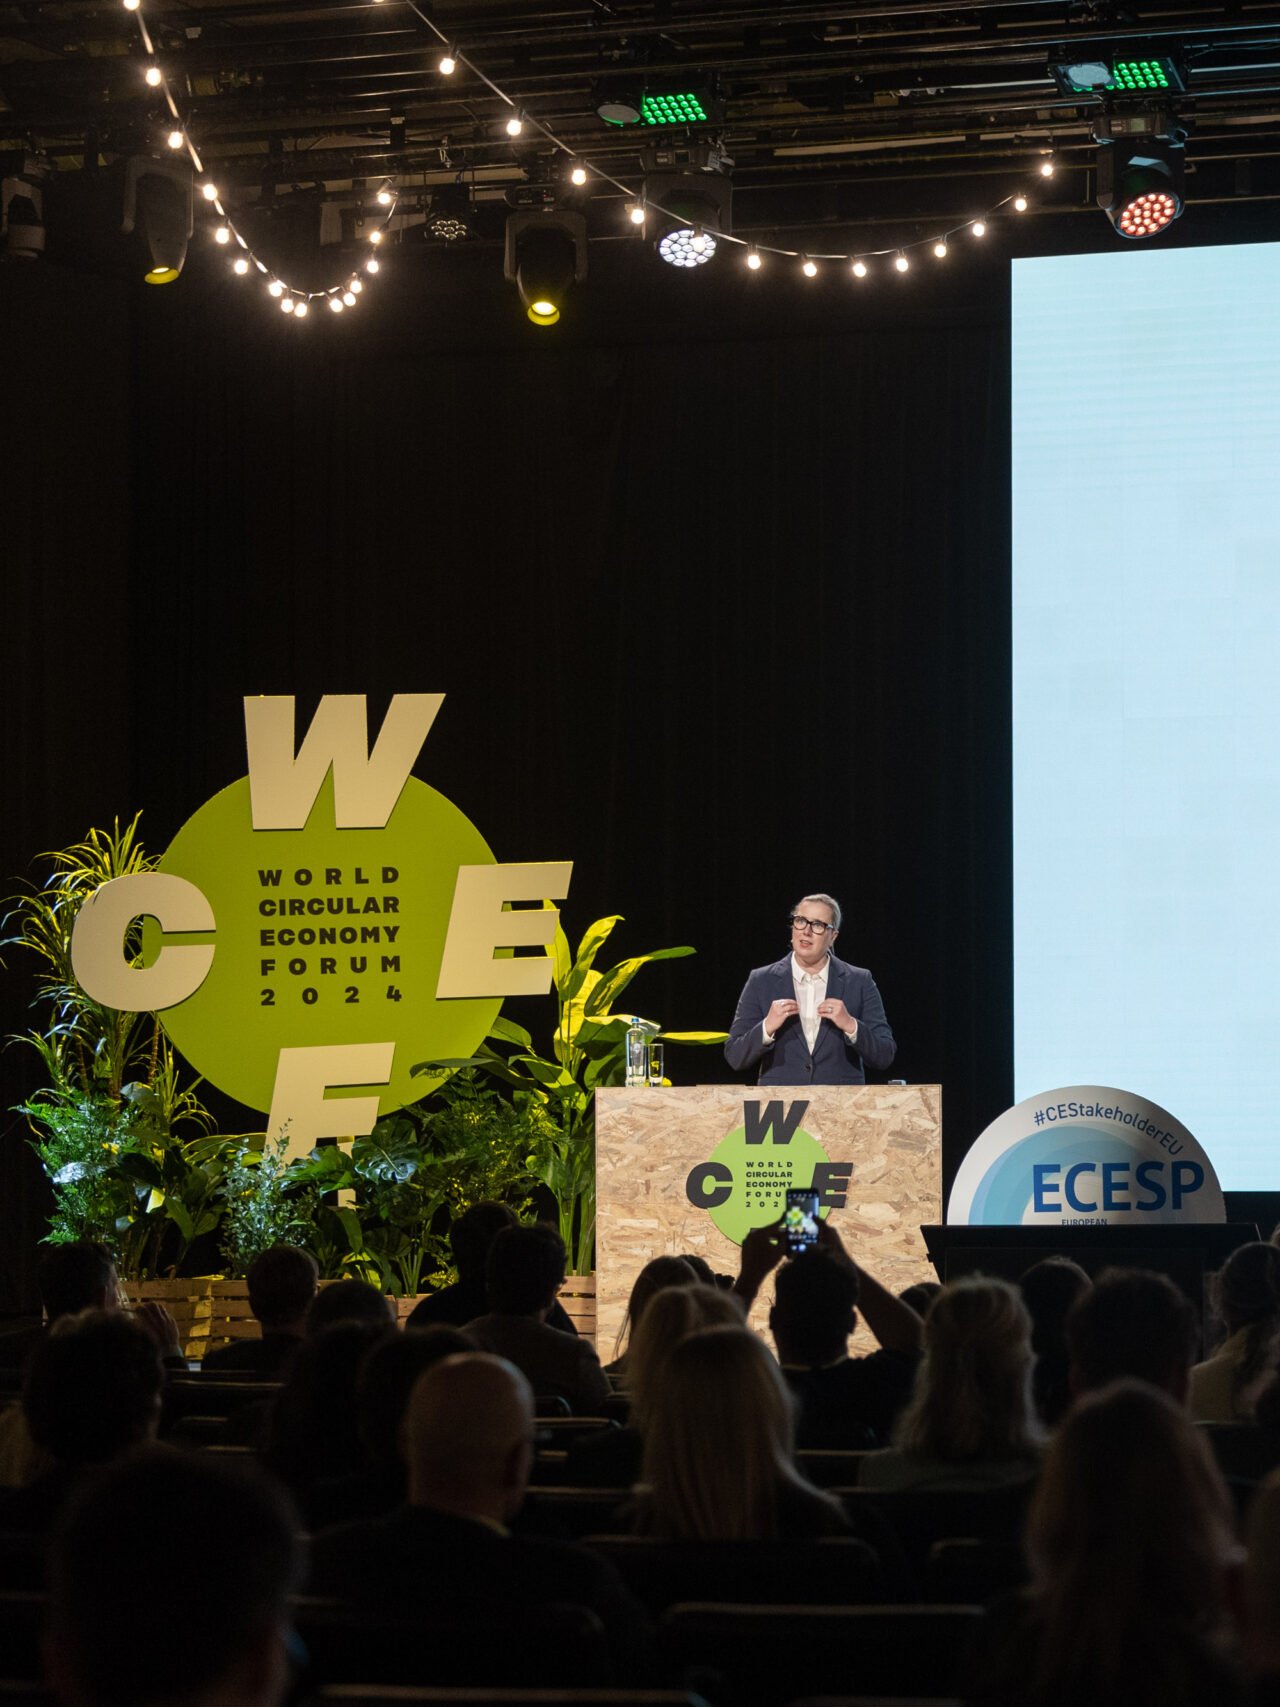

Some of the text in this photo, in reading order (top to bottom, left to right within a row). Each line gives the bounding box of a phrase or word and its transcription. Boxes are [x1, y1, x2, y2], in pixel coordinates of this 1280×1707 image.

[243, 693, 447, 831] W
[258, 866, 399, 887] WORLD
[258, 896, 400, 917] CIRCULAR
[71, 872, 216, 1012] C
[259, 925, 400, 947] ECONOMY
[435, 861, 574, 999] E
[260, 955, 401, 977] FORUM
[260, 985, 402, 1007] 2024
[743, 1100, 810, 1145] W
[1033, 1102, 1184, 1156] #CEStakeholderEU
[686, 1162, 733, 1209] C
[810, 1162, 853, 1208] E
[1033, 1160, 1205, 1213] ECESP
